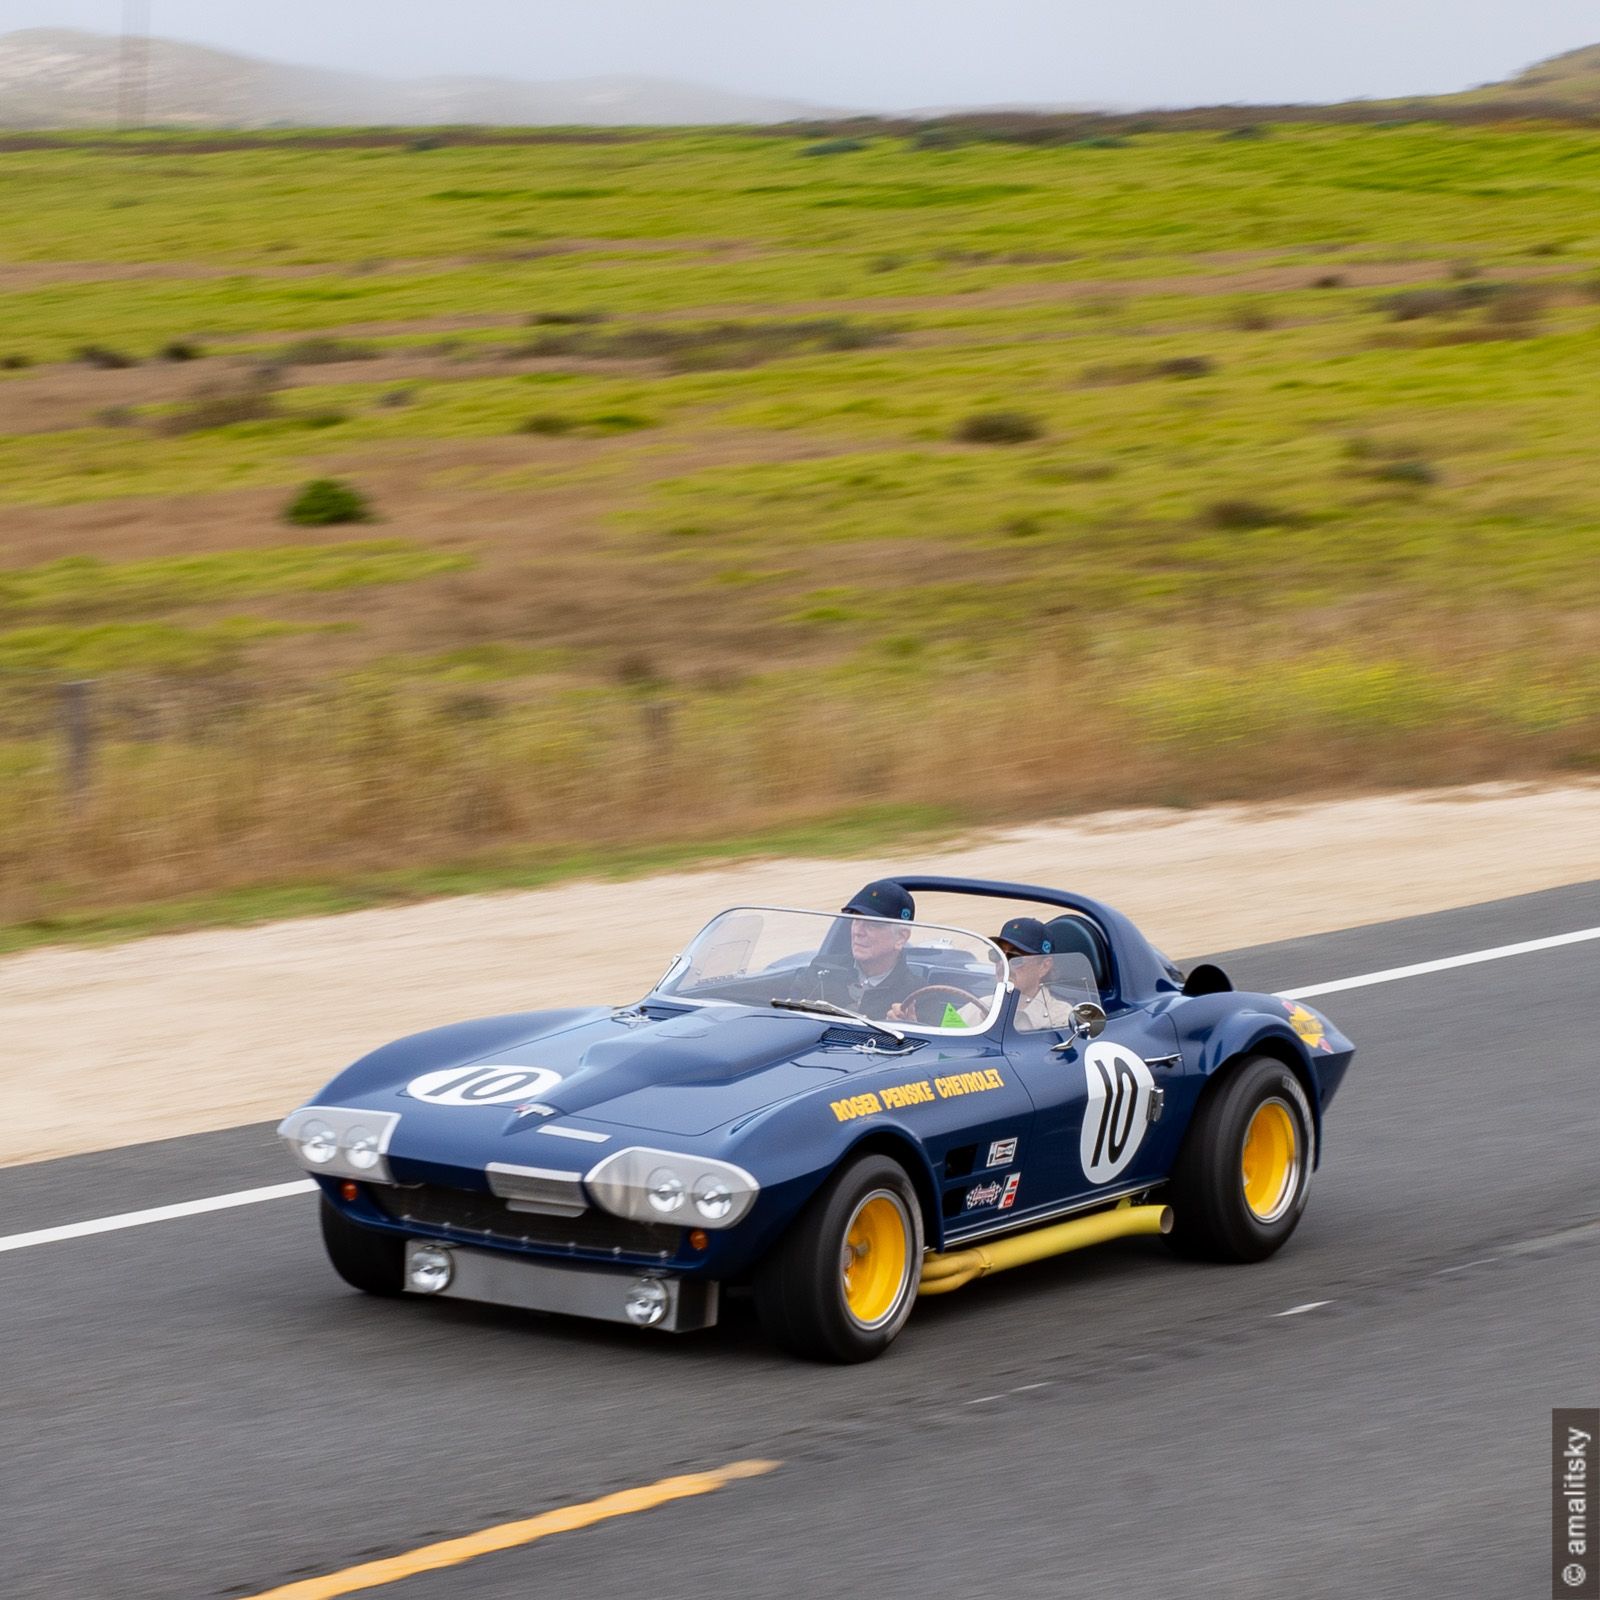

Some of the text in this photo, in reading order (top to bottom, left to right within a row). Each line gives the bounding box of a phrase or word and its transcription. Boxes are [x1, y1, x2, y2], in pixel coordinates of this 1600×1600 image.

[424, 1068, 540, 1100] 10
[830, 1069, 1005, 1122] ROGER PENSKE CHEVROLET
[1091, 1057, 1138, 1168] 10
